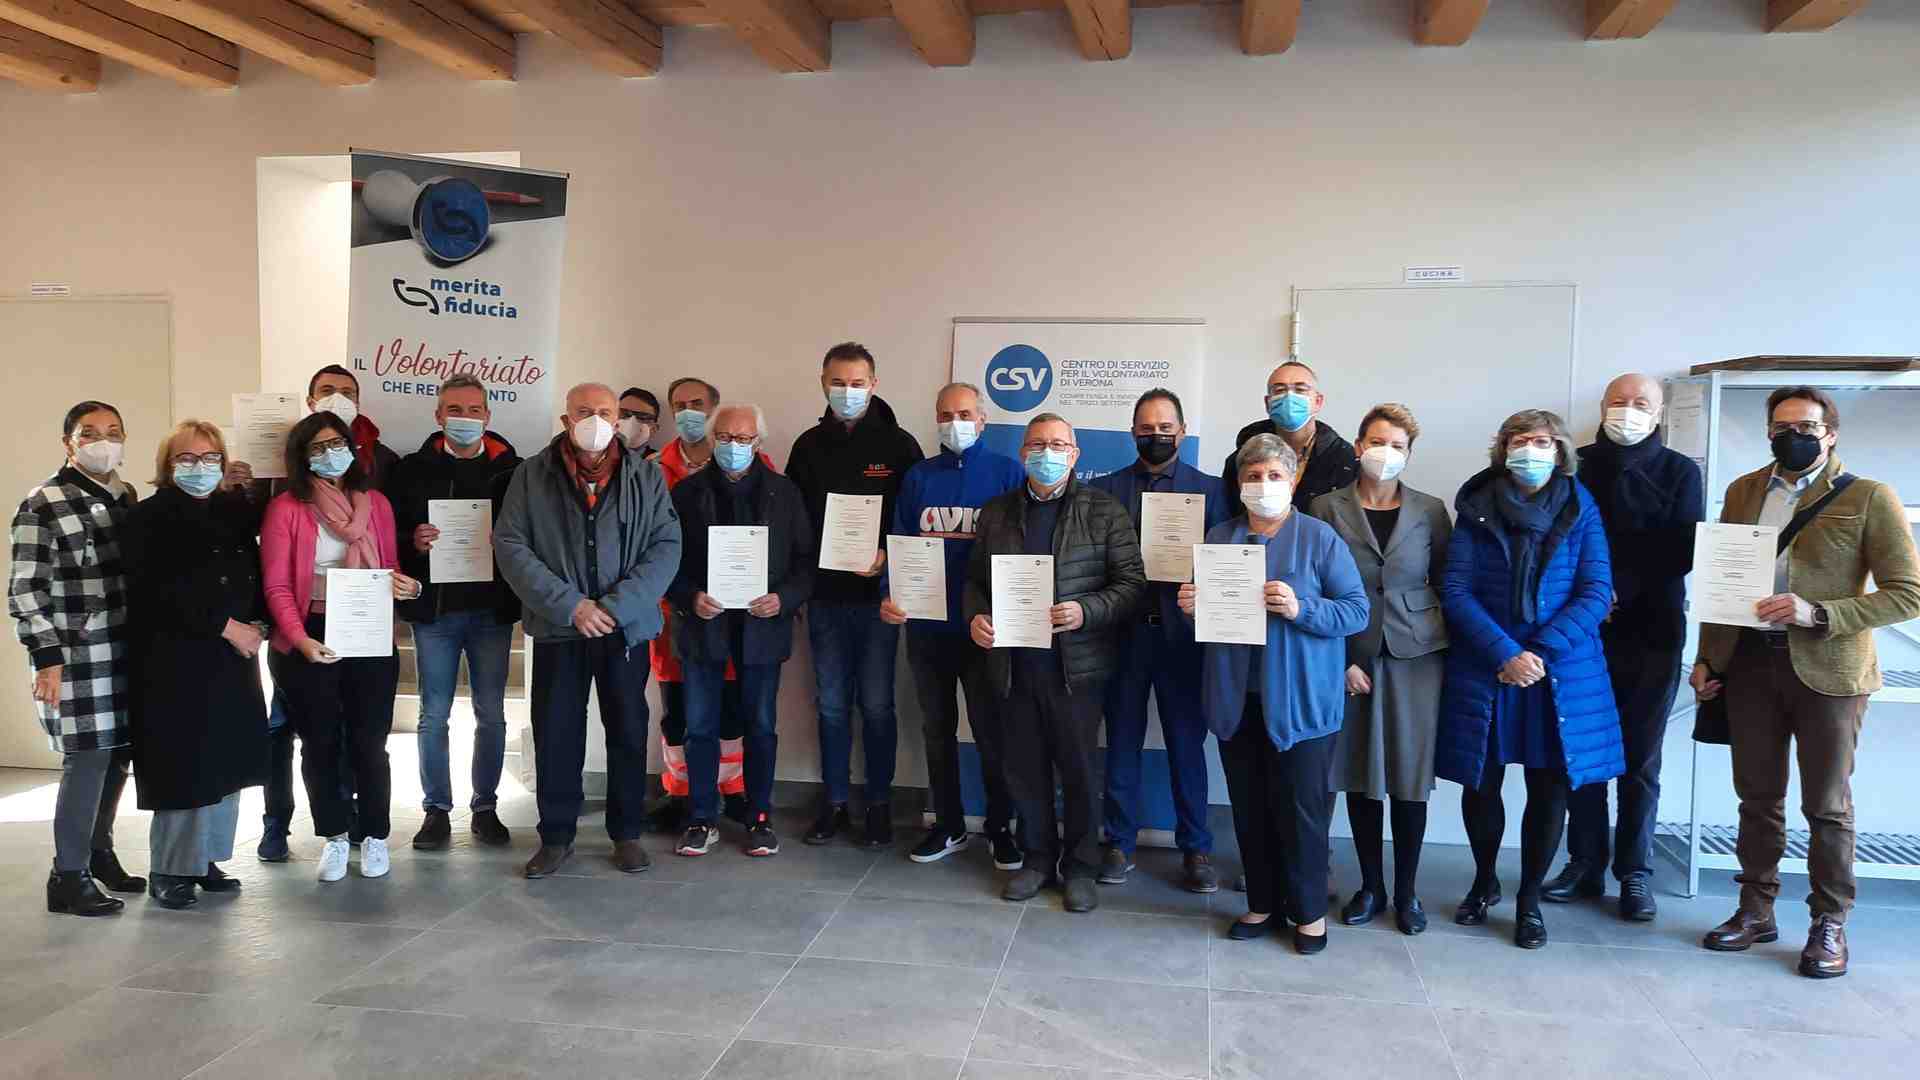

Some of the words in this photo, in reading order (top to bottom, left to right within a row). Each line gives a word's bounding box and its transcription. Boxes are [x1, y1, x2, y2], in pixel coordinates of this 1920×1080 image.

[430, 278, 501, 297] merita
[444, 297, 518, 319] fiducia
[354, 358, 368, 371] IL
[374, 338, 546, 386] Volontariato
[1060, 360, 1105, 369] CENTRO
[1107, 360, 1118, 369] DI
[1120, 360, 1170, 370] SERVIZIO
[990, 367, 1048, 391] CSV
[1060, 369, 1080, 378] PER
[1092, 369, 1169, 379] VOLONTARIATO
[1060, 378, 1070, 387] DI
[1073, 378, 1114, 387] VERONA
[382, 380, 412, 394] CHE
[489, 389, 517, 402] NTO
